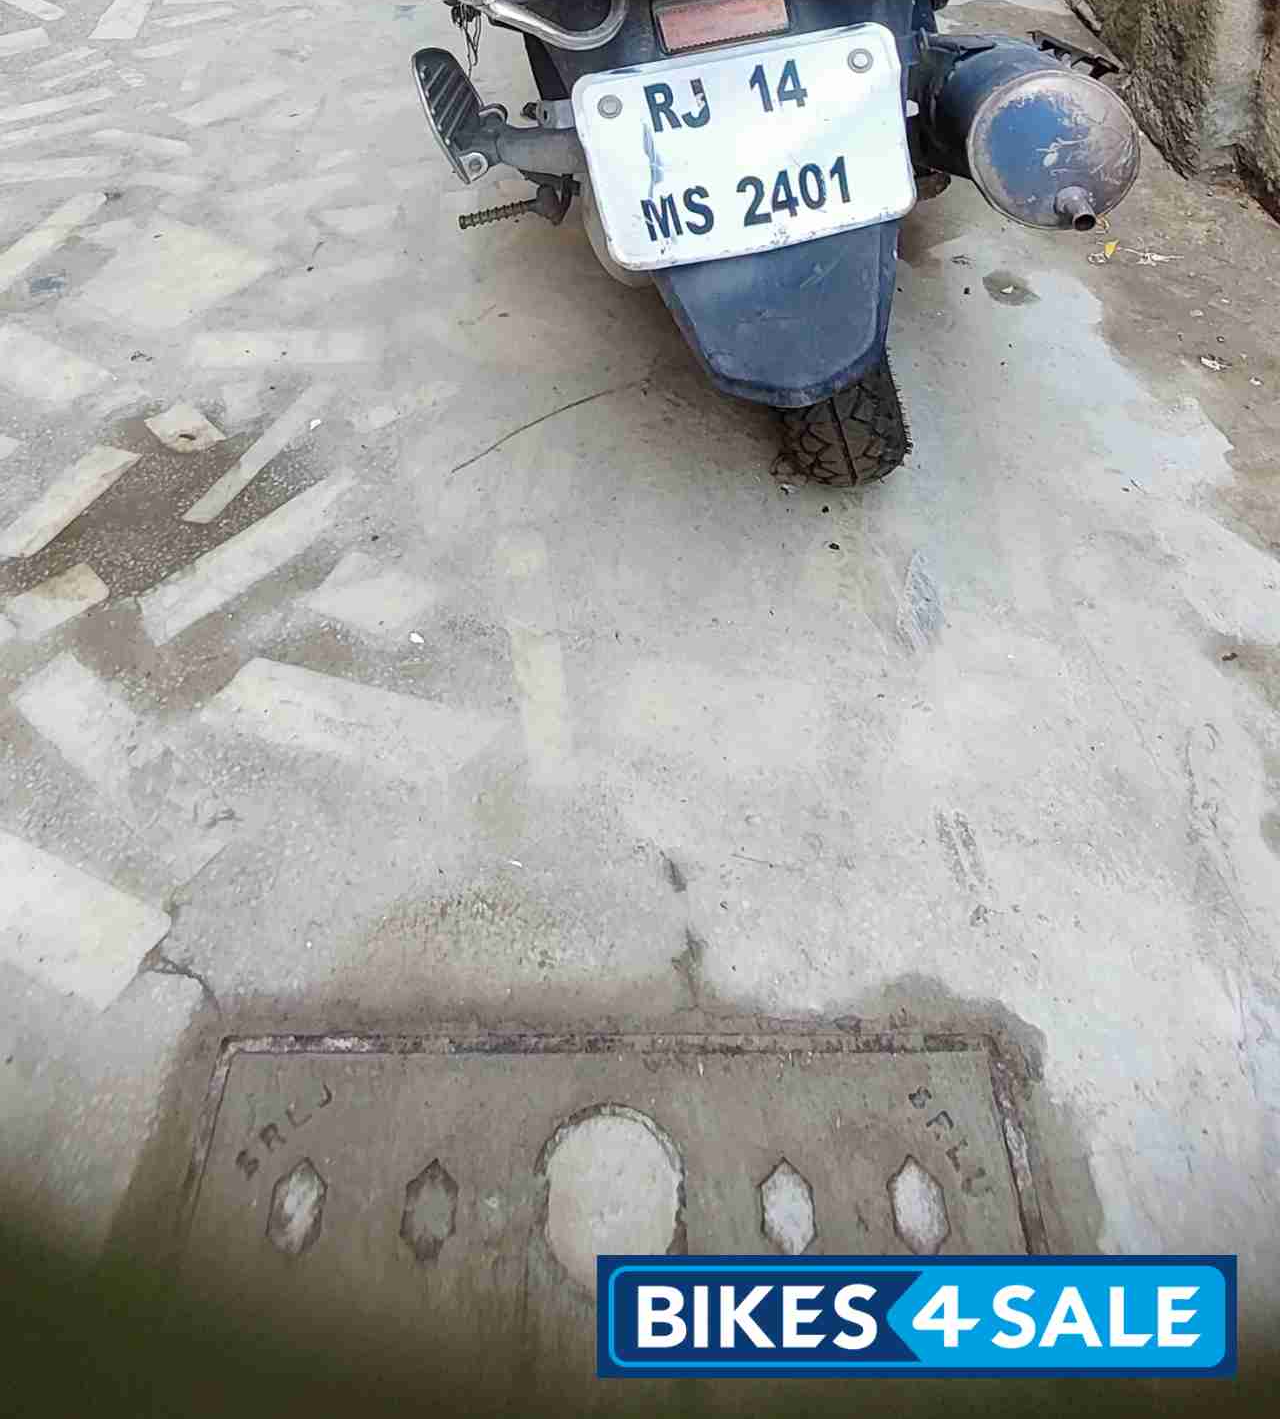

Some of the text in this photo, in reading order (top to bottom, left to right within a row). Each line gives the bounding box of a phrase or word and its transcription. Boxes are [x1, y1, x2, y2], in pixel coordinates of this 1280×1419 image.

[643, 58, 809, 133] RJ 14
[640, 155, 850, 242] MS 2401
